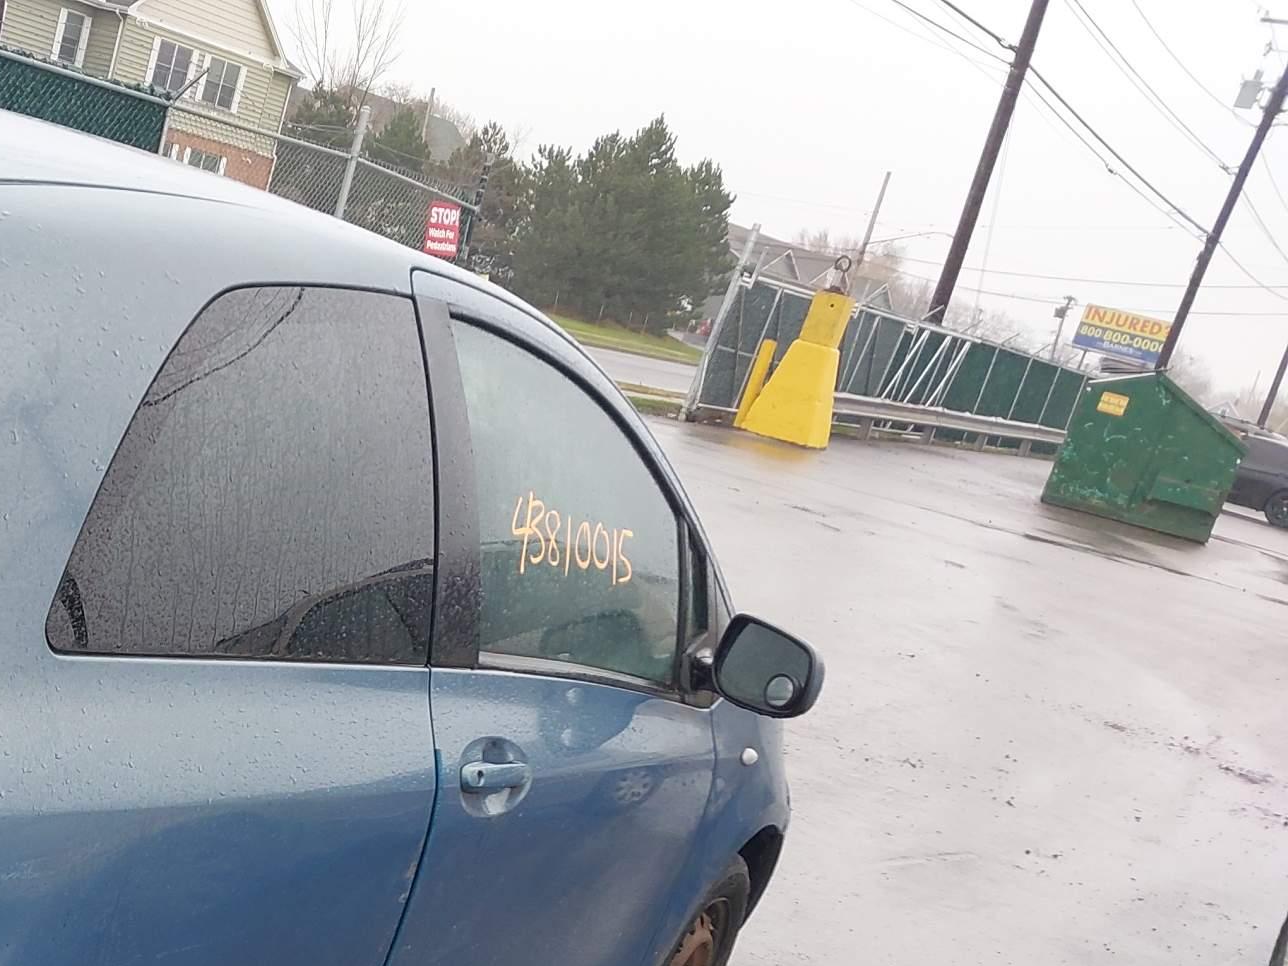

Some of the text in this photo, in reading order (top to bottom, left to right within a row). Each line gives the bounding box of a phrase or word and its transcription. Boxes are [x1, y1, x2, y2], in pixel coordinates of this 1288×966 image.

[430, 206, 461, 227] STOP!
[1079, 324, 1102, 338] 800
[512, 490, 634, 585] 43810015
